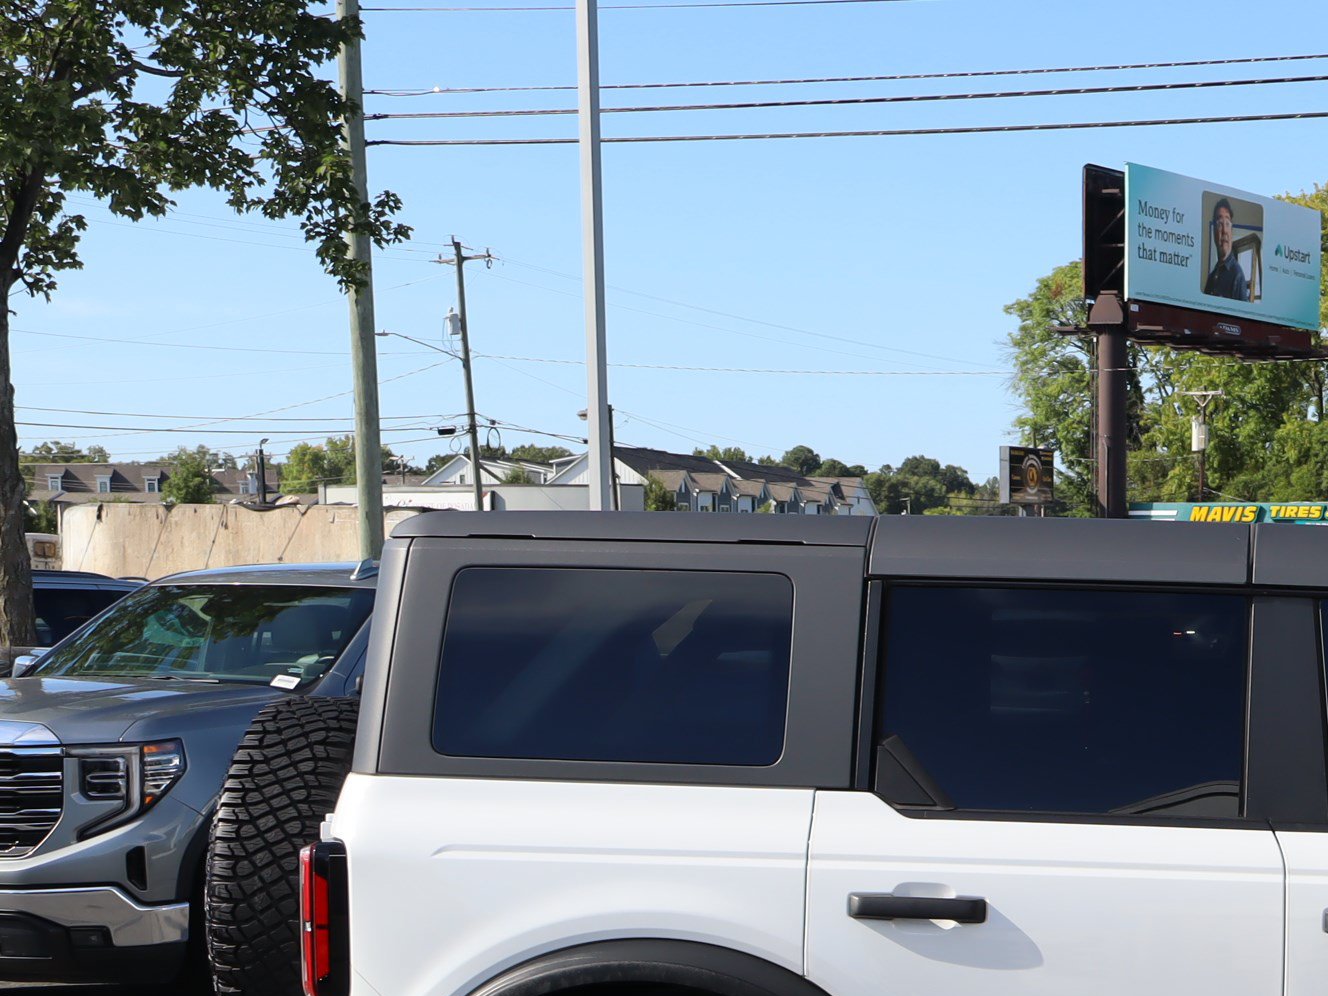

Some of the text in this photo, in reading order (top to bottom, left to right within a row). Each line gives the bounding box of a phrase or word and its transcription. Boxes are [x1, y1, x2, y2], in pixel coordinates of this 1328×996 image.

[1138, 199, 1184, 224] Money for
[1138, 222, 1195, 247] the moments
[1138, 242, 1157, 261] that
[1284, 245, 1311, 264] Upstart
[1190, 506, 1257, 522] MAVIS
[1270, 505, 1322, 518] TIRES
